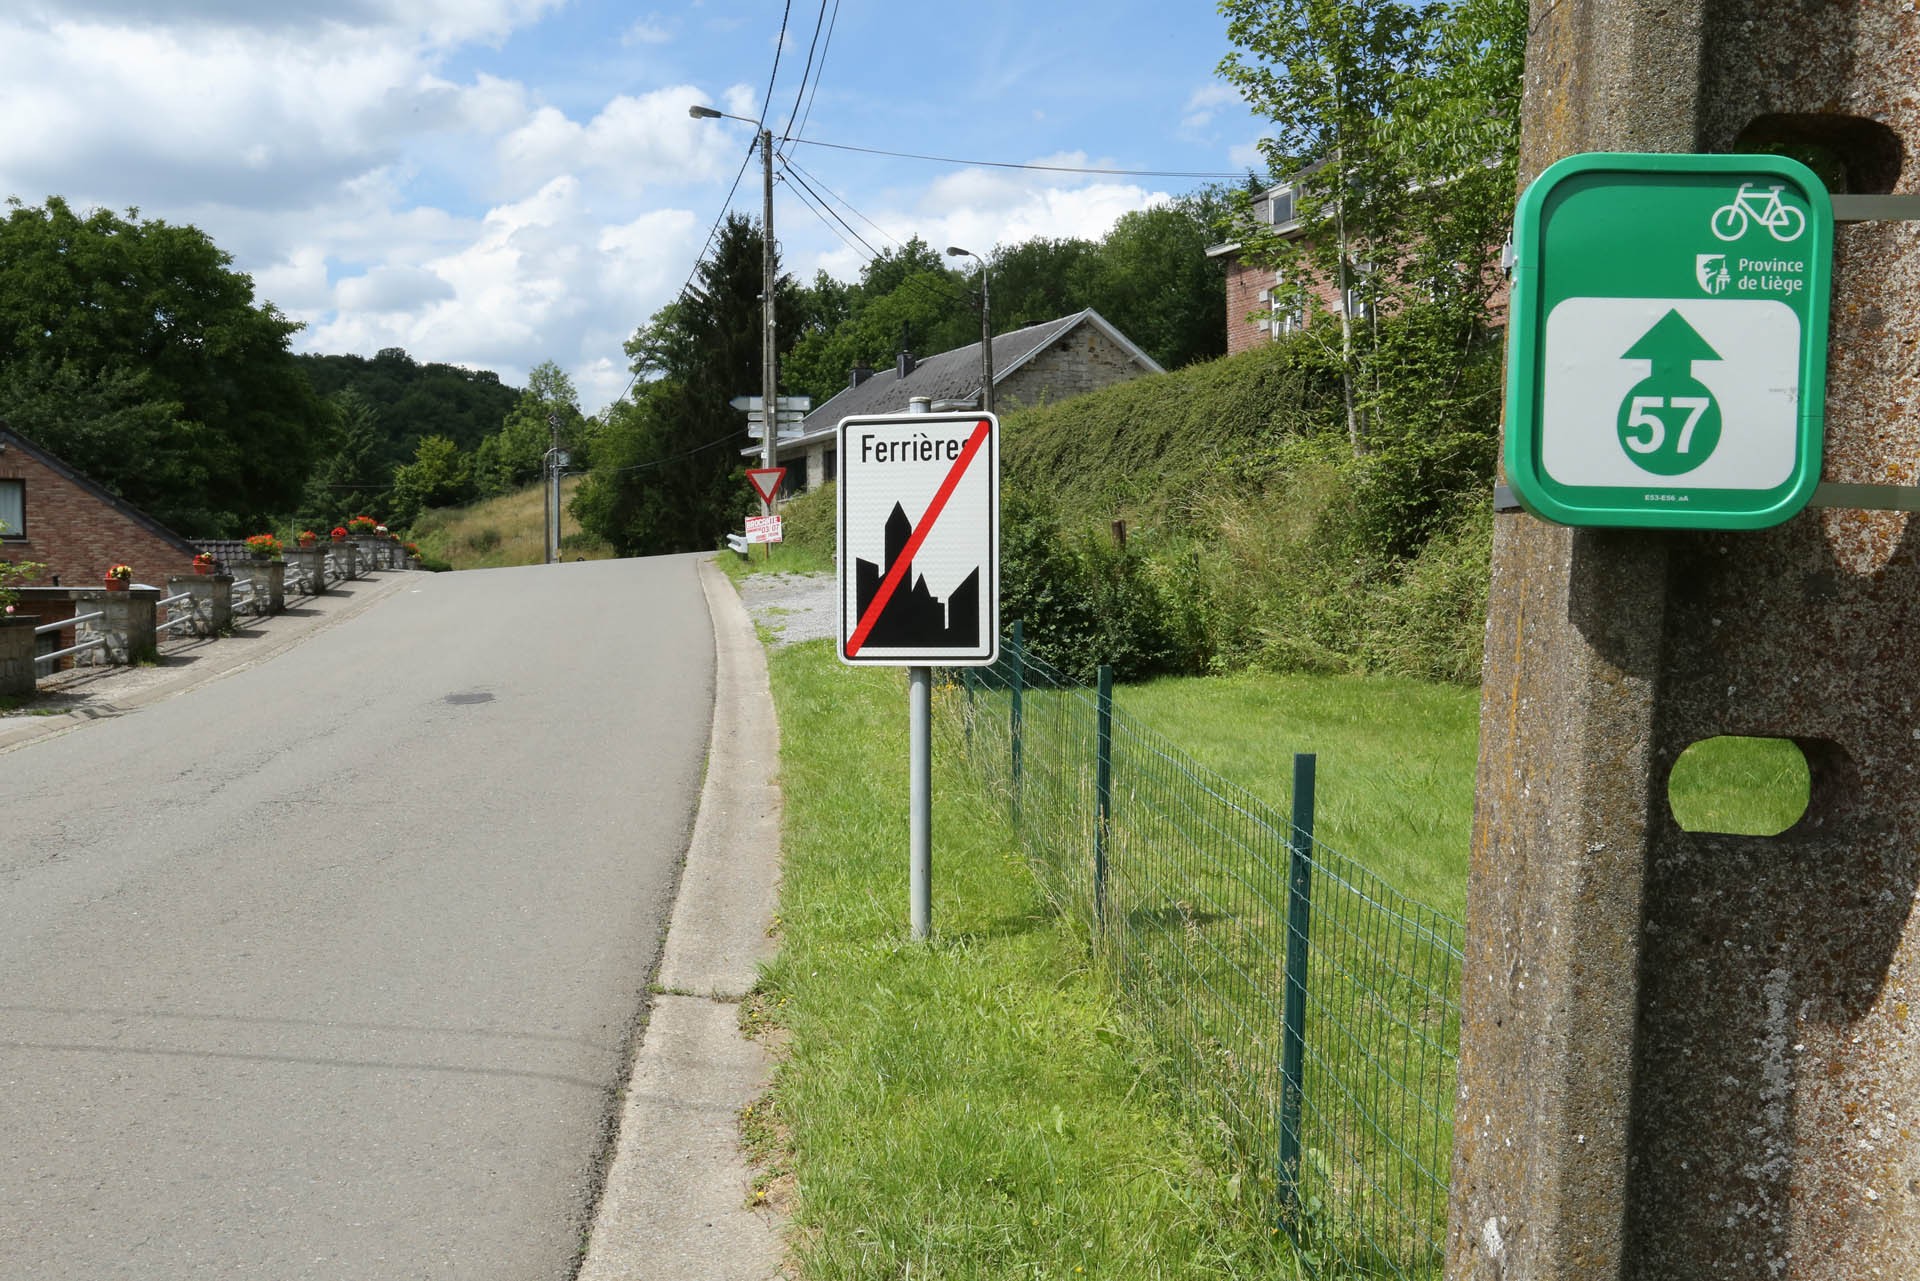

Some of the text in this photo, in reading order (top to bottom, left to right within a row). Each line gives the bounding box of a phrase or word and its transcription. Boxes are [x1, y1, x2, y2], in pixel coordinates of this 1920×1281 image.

[1739, 257, 1804, 273] Province
[1738, 275, 1803, 296] de Liège
[1625, 396, 1710, 454] 57
